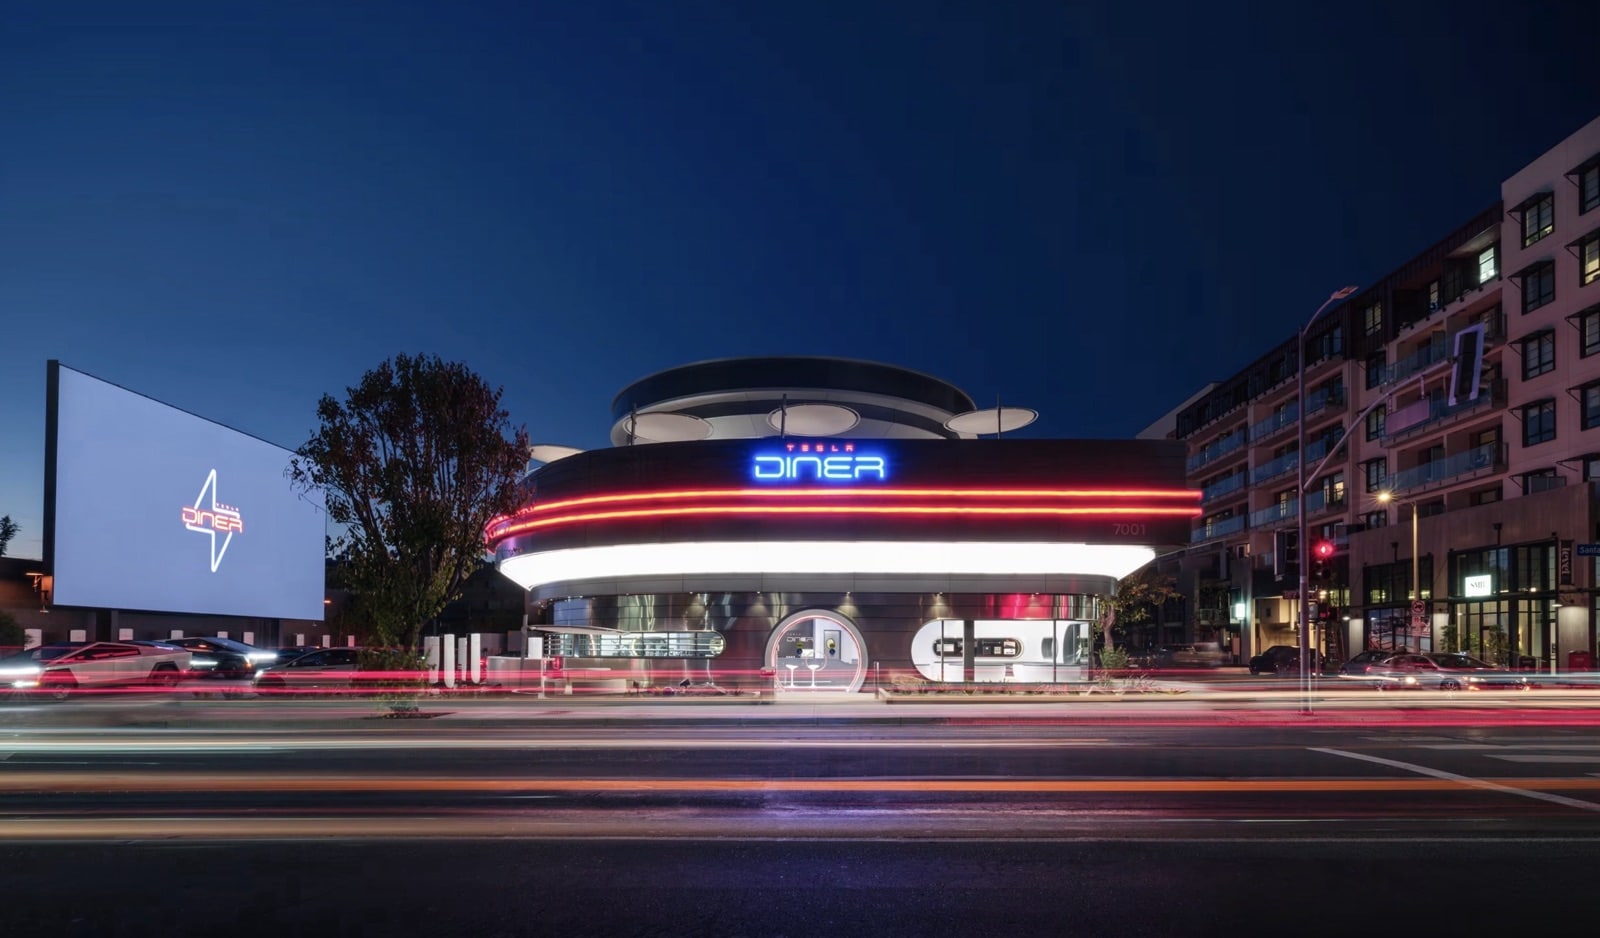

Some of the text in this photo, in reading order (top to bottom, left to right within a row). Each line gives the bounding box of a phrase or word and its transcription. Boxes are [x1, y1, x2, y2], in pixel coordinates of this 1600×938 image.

[786, 444, 854, 452] TESLA
[755, 456, 885, 478] DINER
[182, 507, 243, 533] DINER
[1113, 523, 1146, 536] 7001
